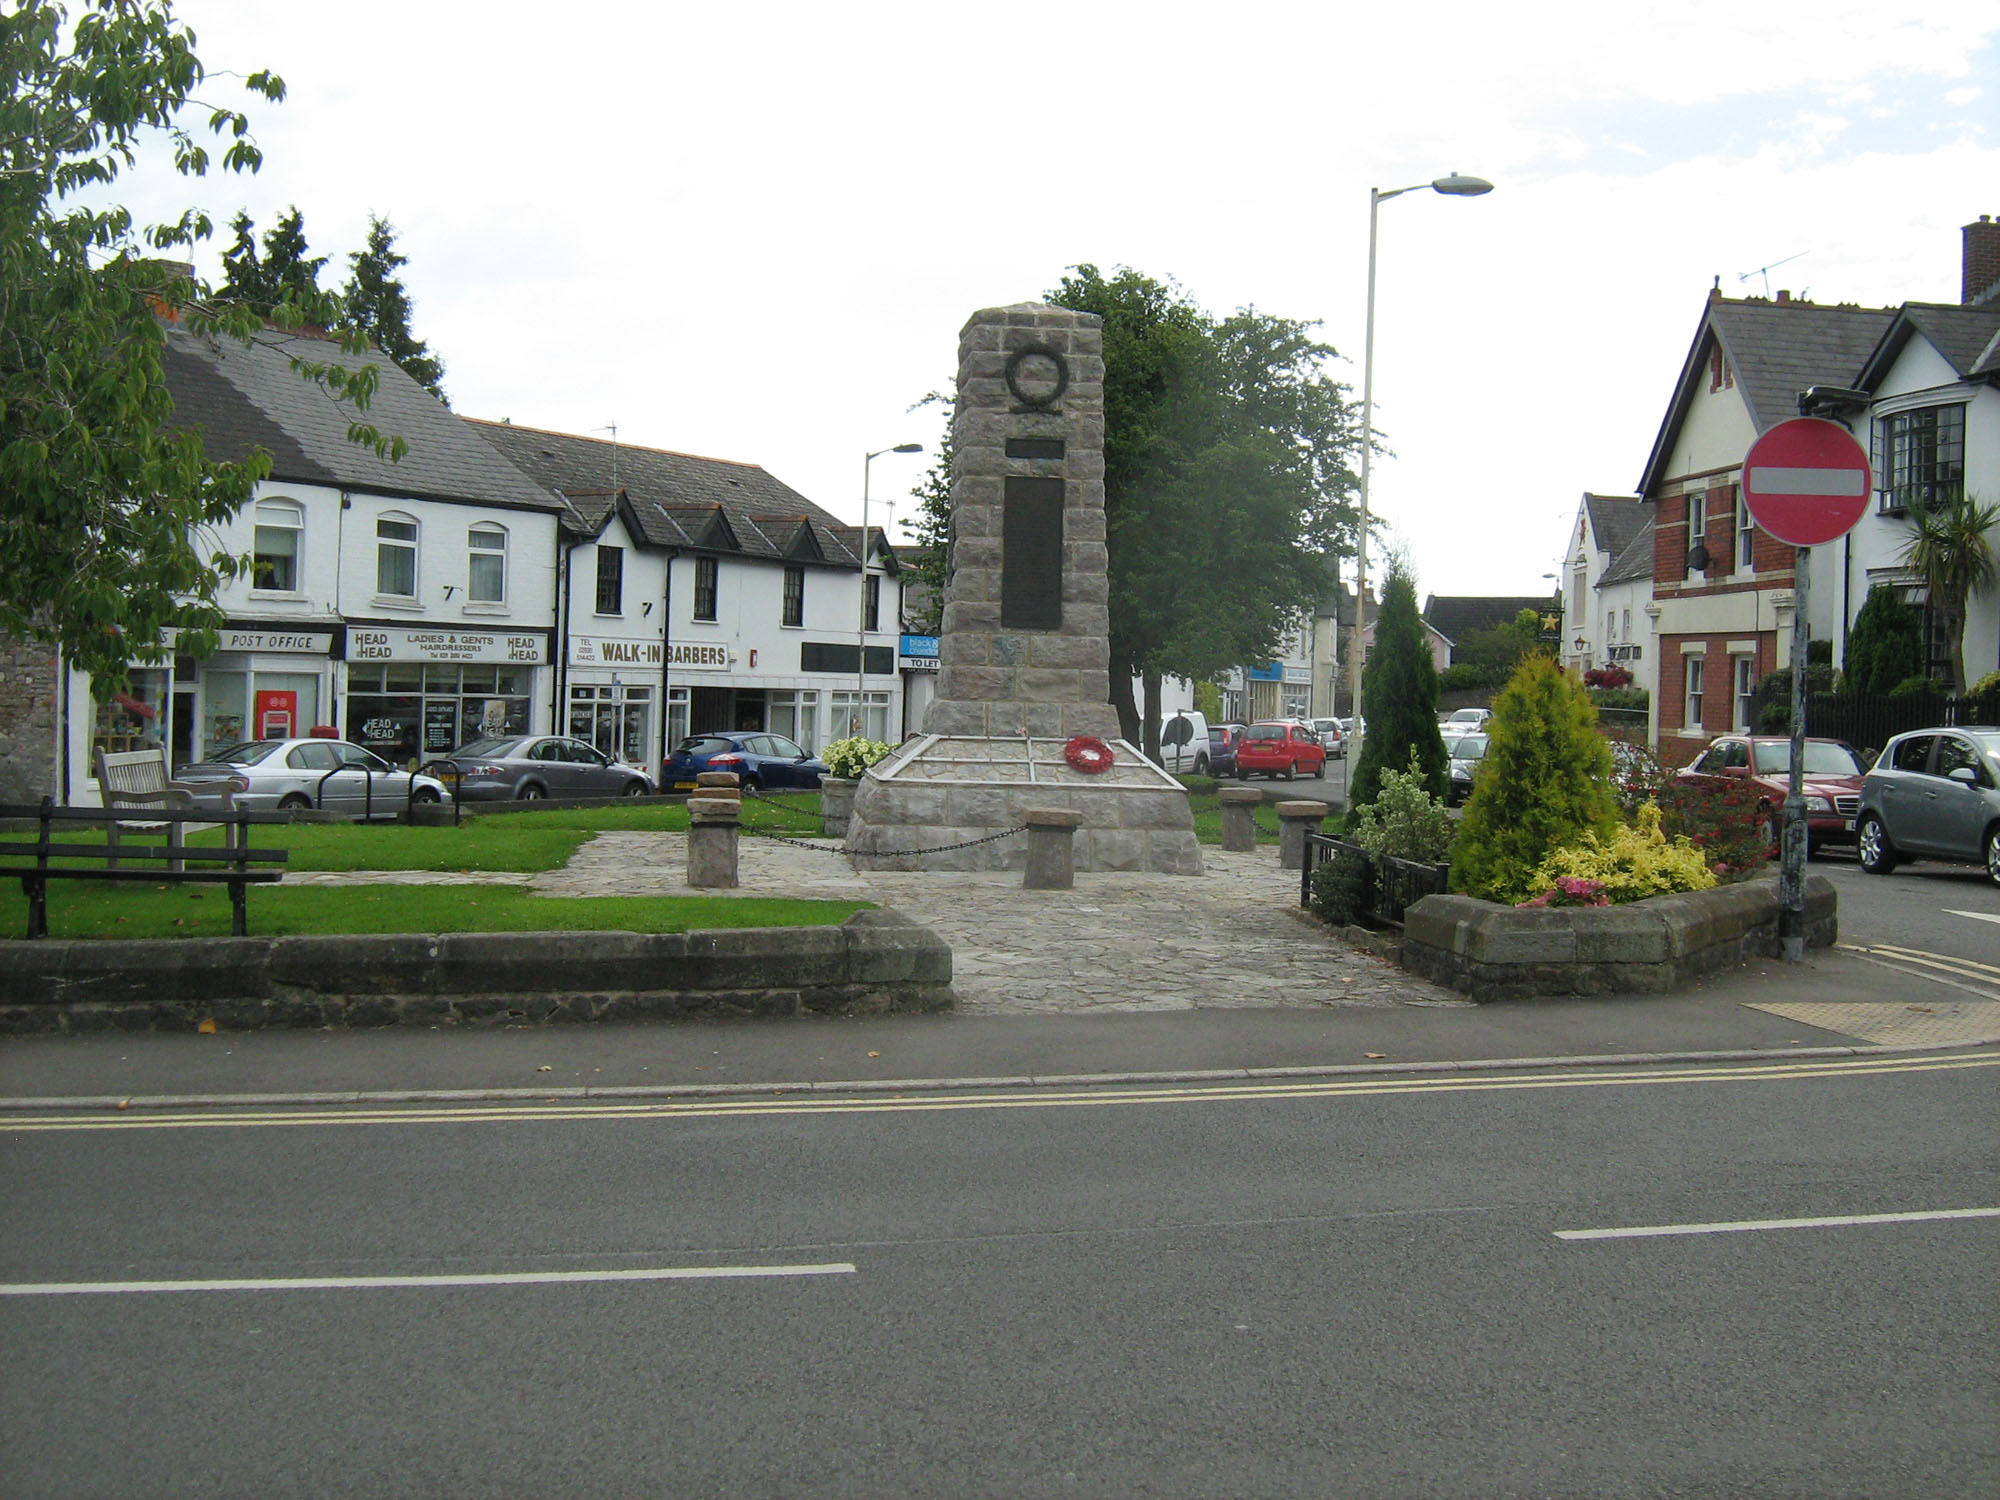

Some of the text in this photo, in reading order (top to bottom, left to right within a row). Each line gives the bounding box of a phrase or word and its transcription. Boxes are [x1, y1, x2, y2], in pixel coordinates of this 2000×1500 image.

[230, 634, 313, 648] POST OFFICE
[355, 633, 388, 645] HEAD
[407, 634, 445, 643] LADIES
[460, 636, 494, 645] GENTS
[507, 637, 535, 648] HEAD
[580, 638, 592, 646] TEL
[360, 647, 392, 658] HEAD
[420, 644, 482, 652] HAIRDRESSERS
[602, 642, 726, 665] WALK-IN BARBERS
[511, 650, 539, 661] HEAD
[910, 659, 938, 668] TO LET
[367, 718, 392, 729] HEAD
[370, 729, 395, 739] HEAD
